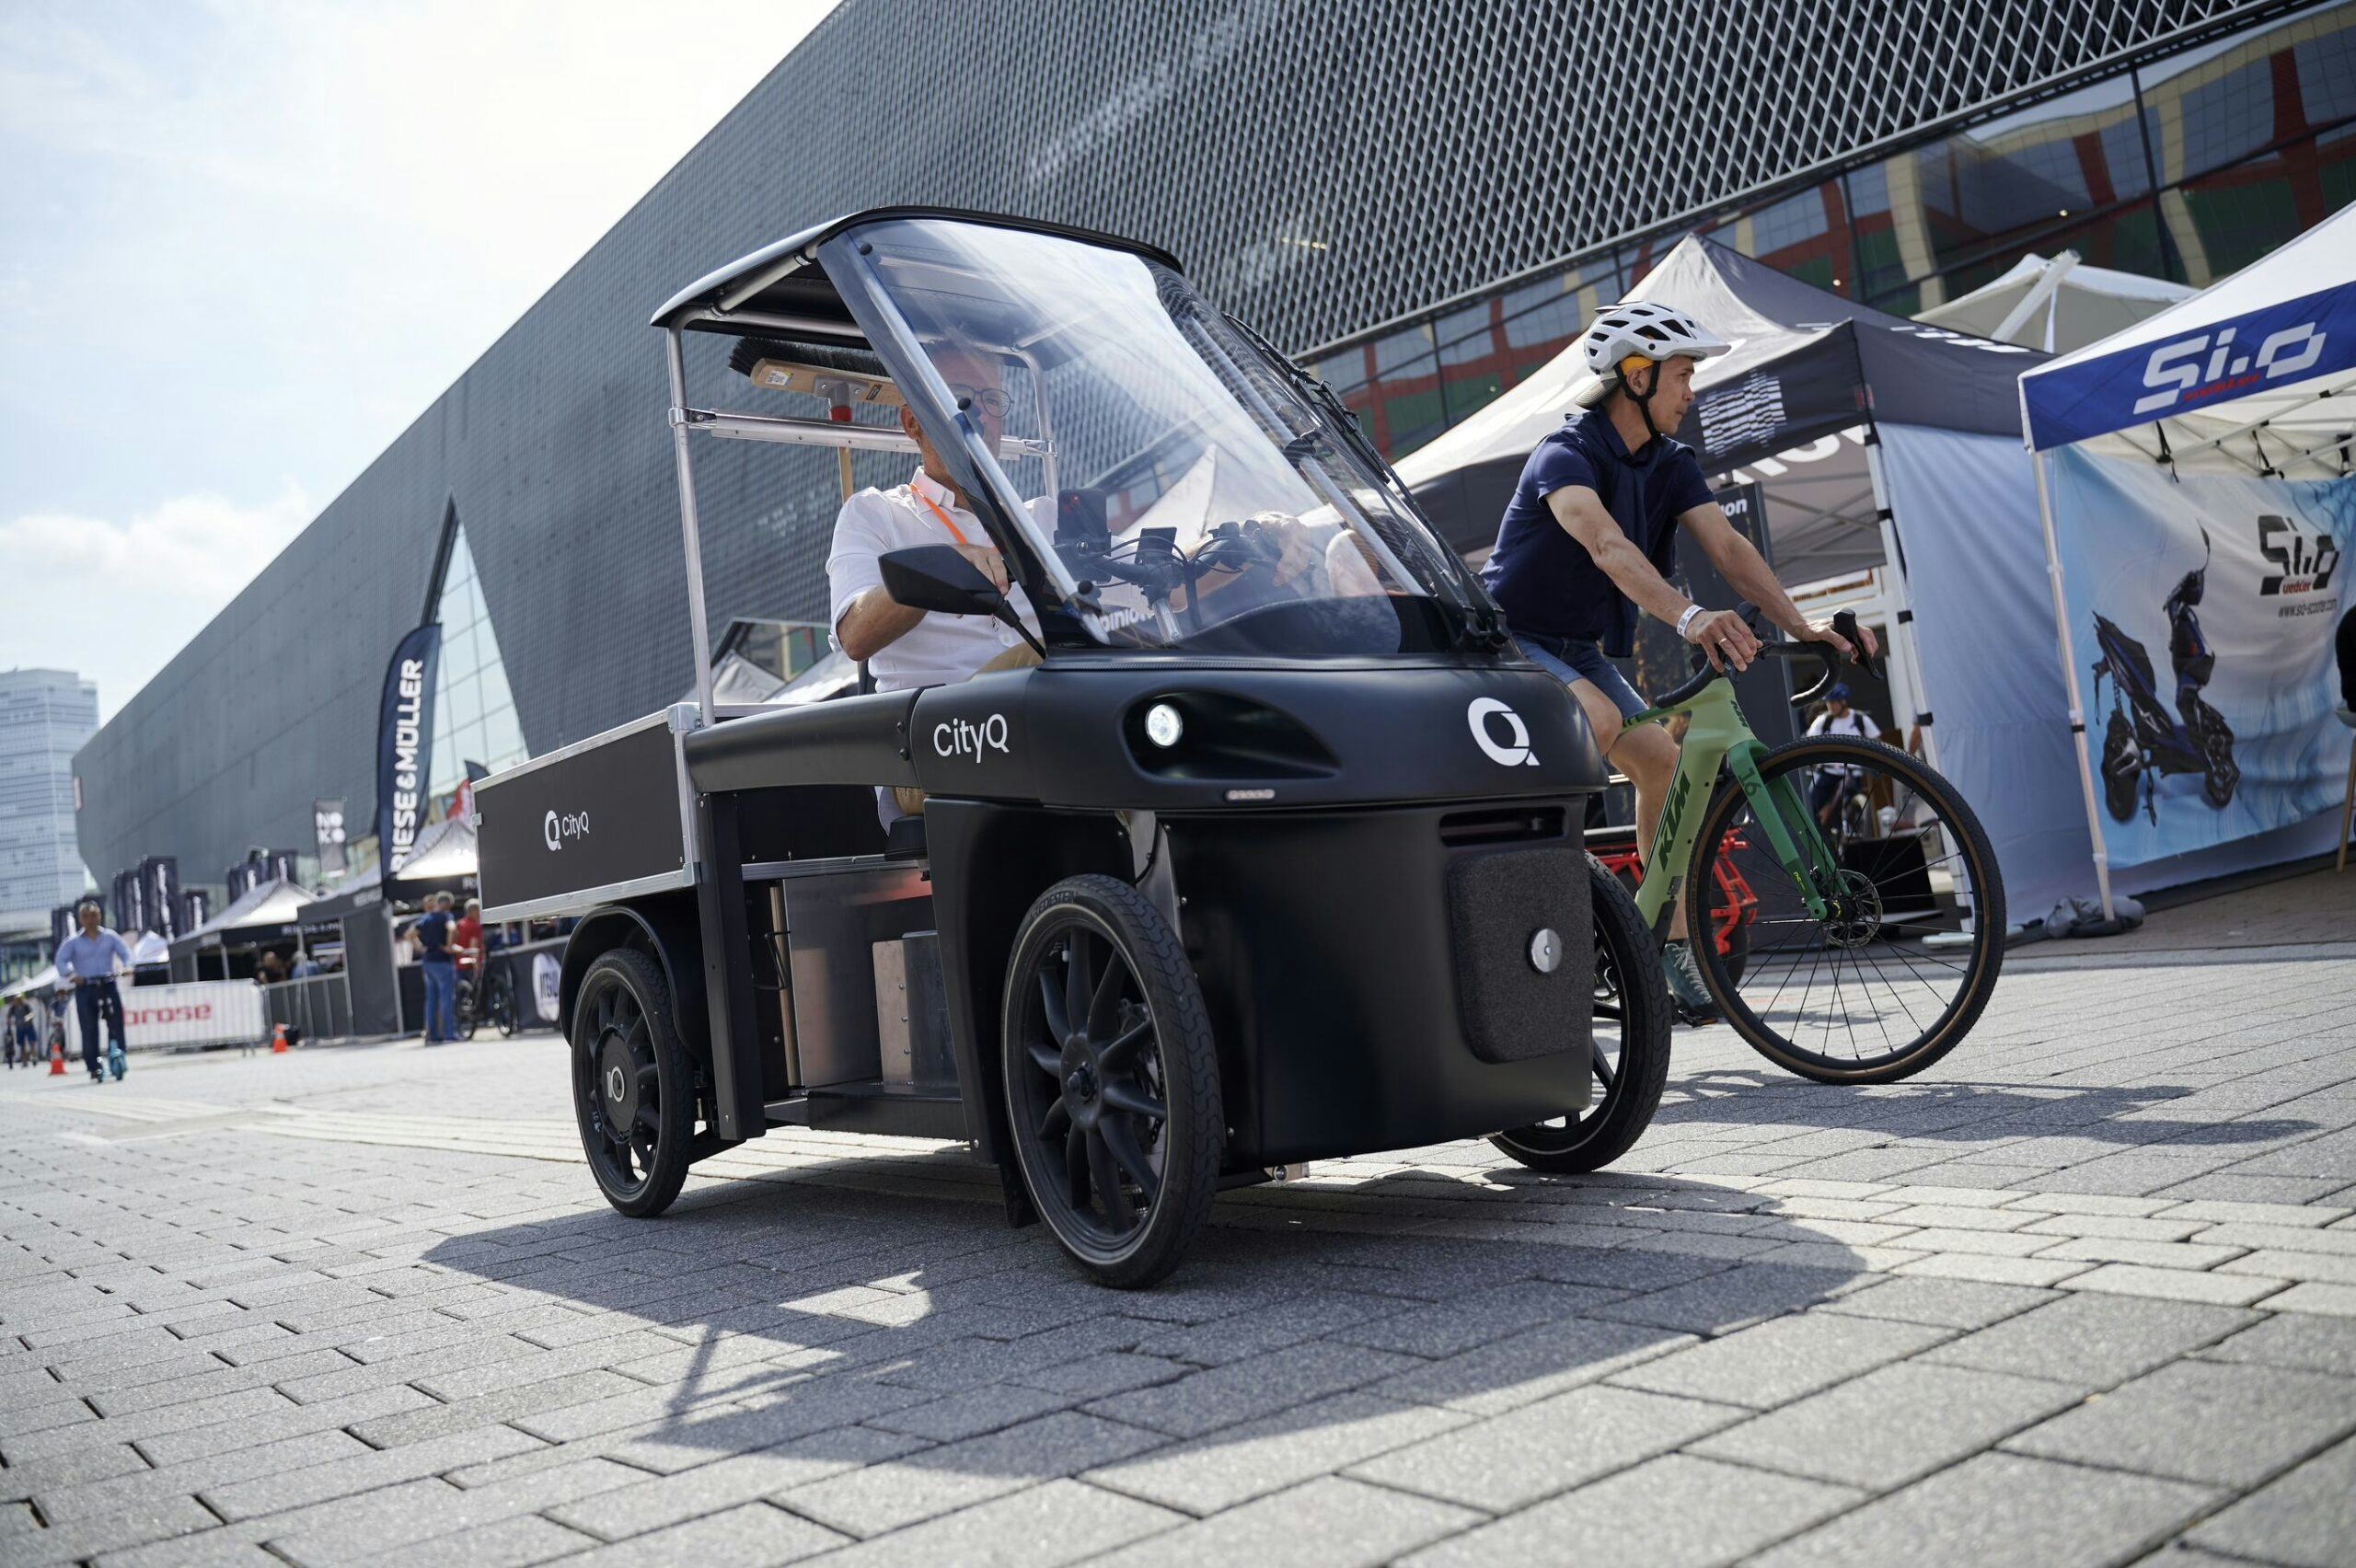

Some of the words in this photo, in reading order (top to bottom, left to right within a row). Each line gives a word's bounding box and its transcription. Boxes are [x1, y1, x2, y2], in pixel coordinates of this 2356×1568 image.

[395, 658, 423, 772] MÜLLER
[933, 713, 1010, 764] CityQ
[1738, 766, 1762, 798] 16
[561, 811, 590, 840] CityQ
[1658, 770, 1691, 871] KTM
